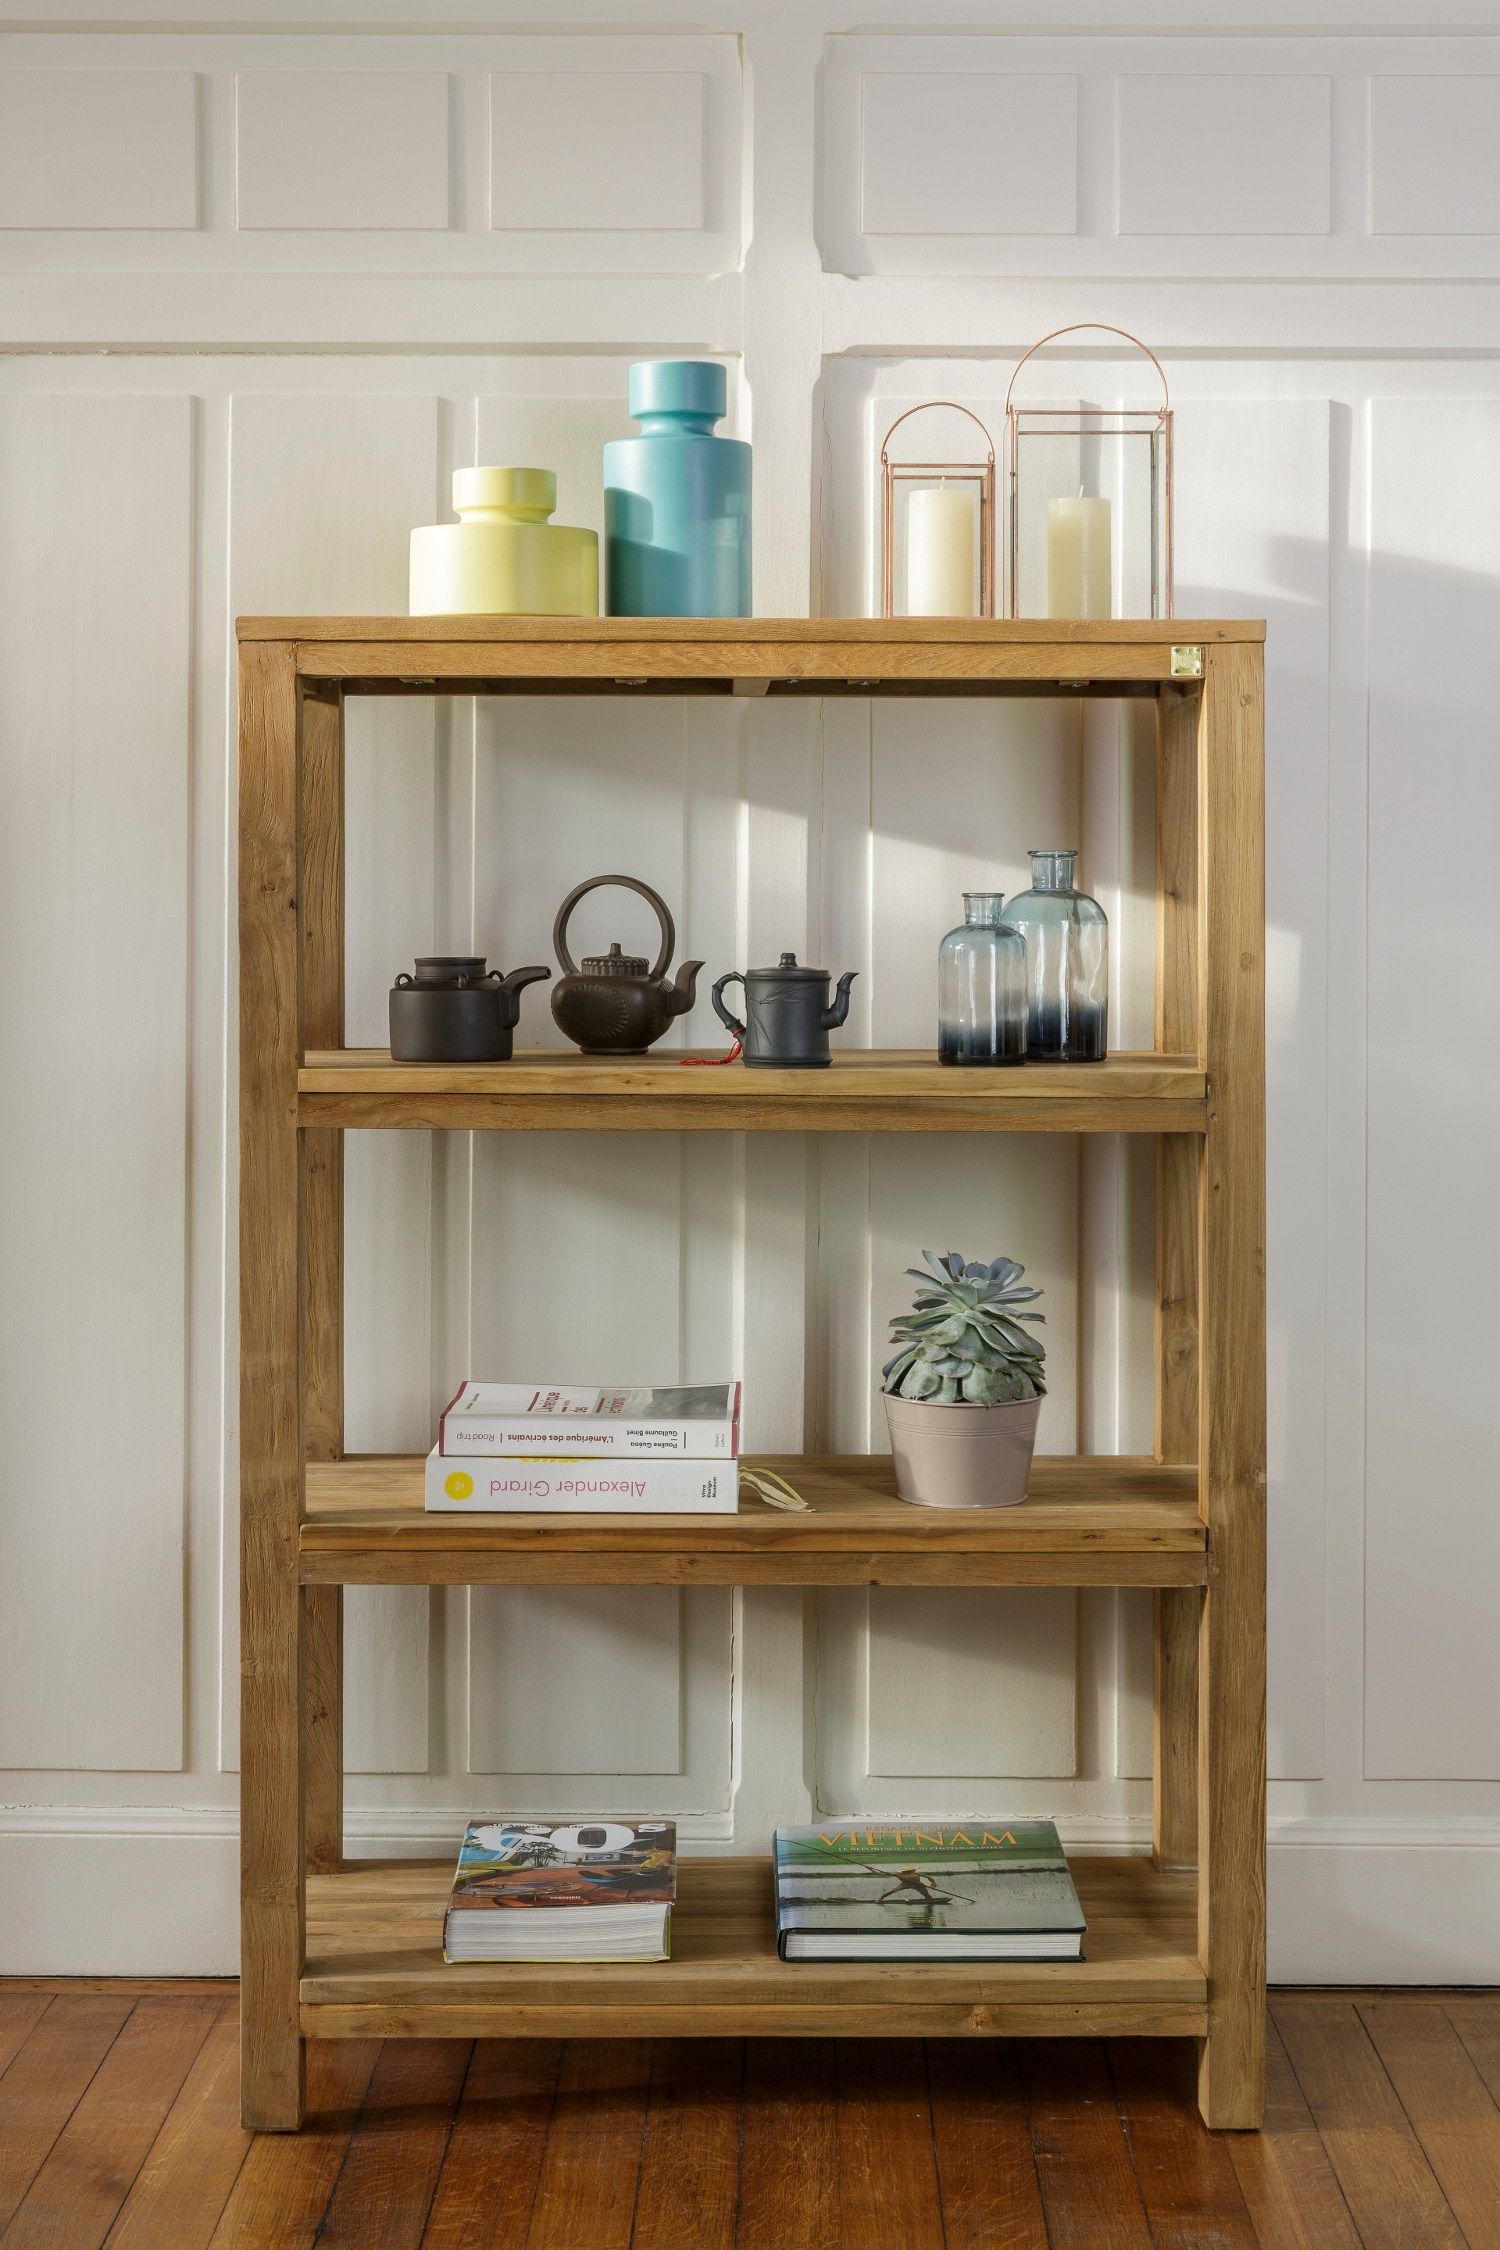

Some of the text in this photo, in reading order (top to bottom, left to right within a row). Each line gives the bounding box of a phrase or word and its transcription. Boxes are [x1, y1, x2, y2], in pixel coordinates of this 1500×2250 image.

[456, 1431, 614, 1444] L'Amérique des écrivains Road trip
[489, 1480, 646, 1498] Alexander Girard
[815, 1829, 1020, 1847] VIETNAM
